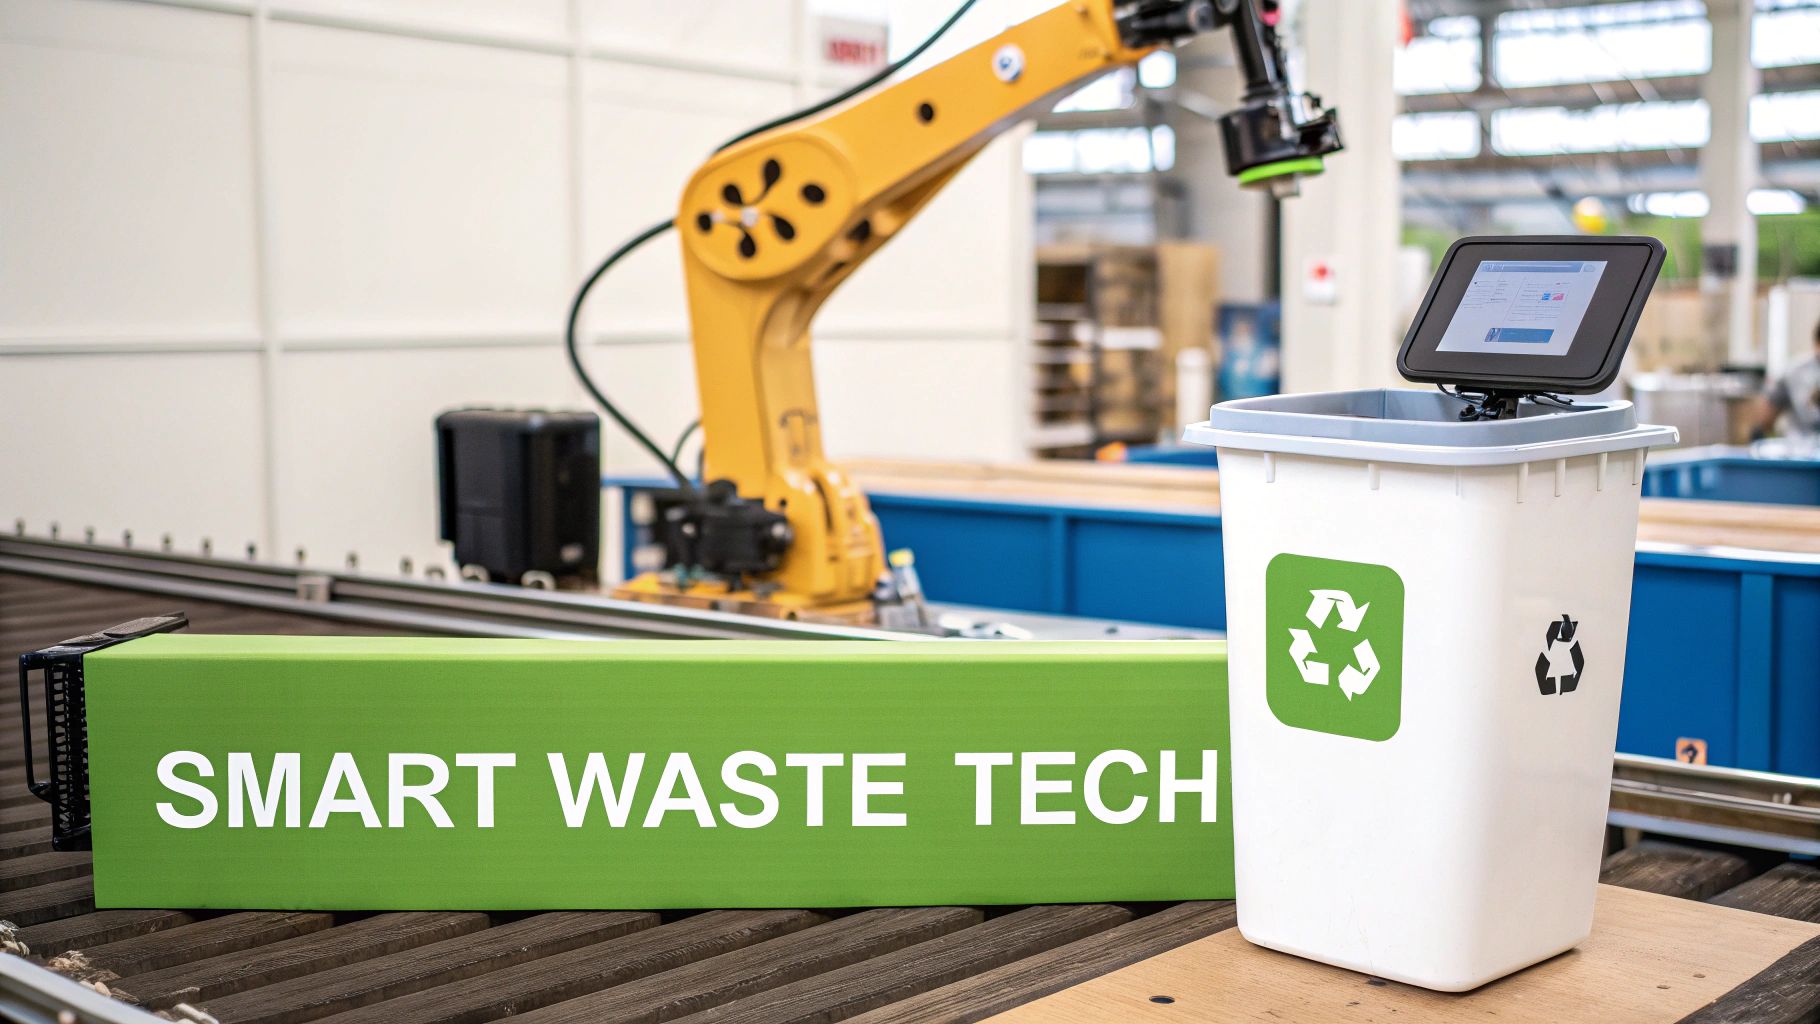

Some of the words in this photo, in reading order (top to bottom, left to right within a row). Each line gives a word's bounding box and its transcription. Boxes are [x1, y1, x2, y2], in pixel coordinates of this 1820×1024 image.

[155, 750, 517, 829] SMART
[546, 750, 907, 829] WASTE
[954, 749, 1218, 826] TECH
